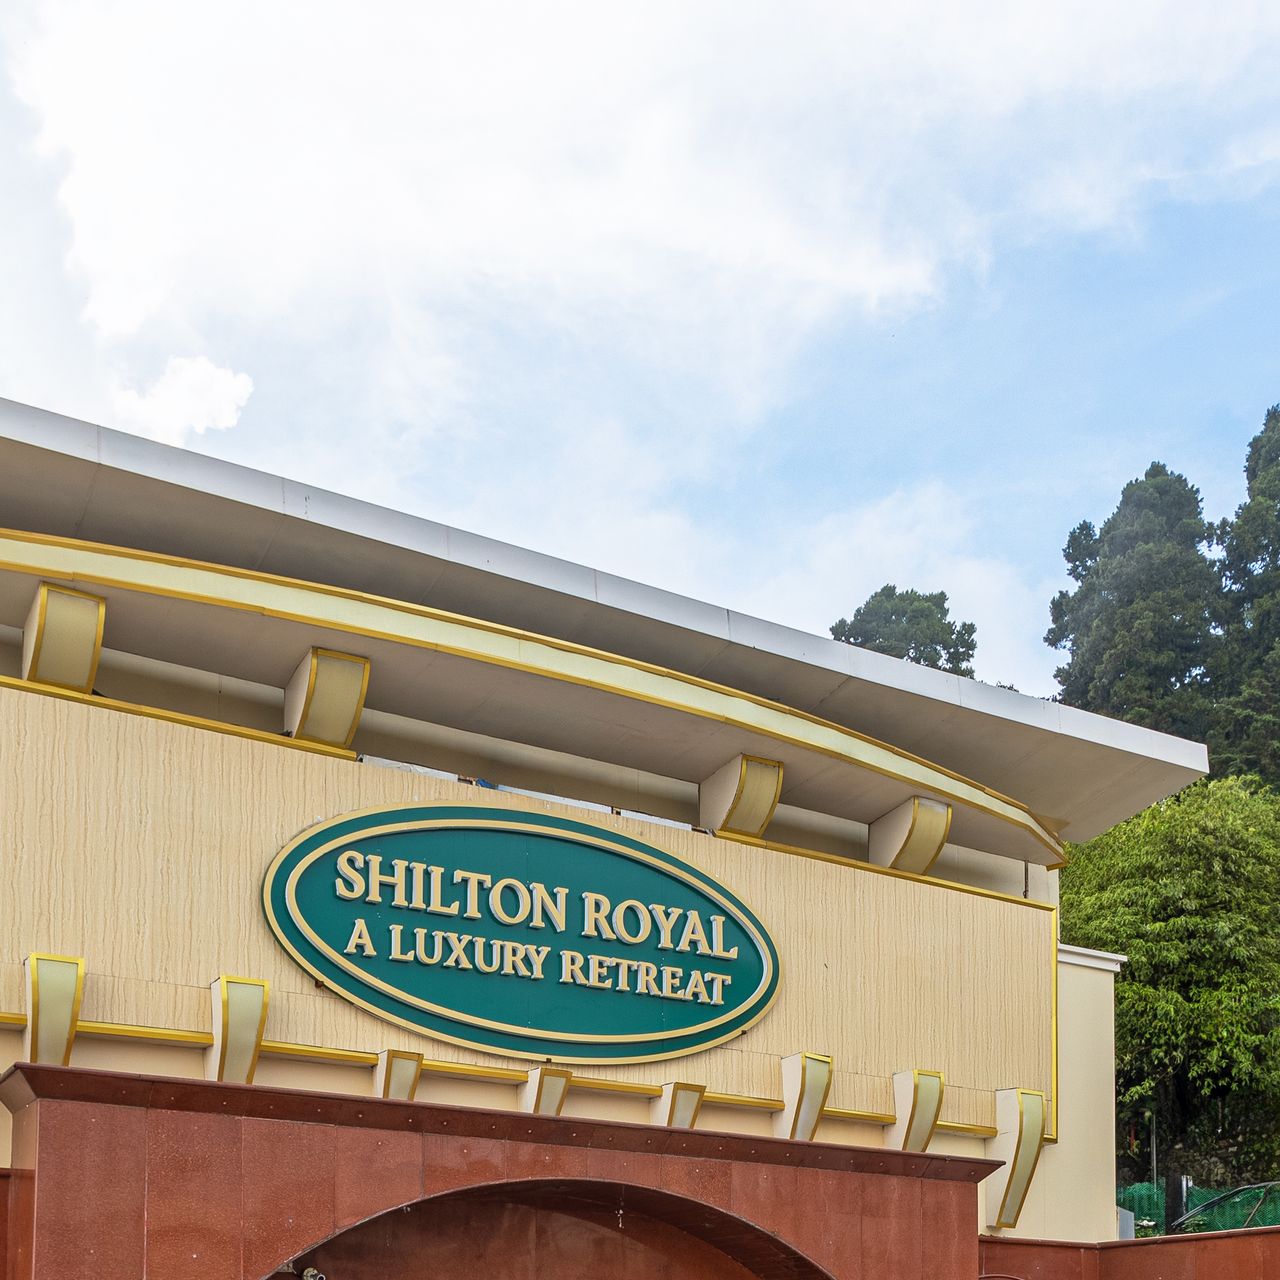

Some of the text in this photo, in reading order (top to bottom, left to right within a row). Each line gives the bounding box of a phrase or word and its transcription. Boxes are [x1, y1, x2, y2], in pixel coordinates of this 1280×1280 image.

[335, 849, 739, 960] SHILTON ROYAL
[344, 918, 732, 1006] A LUXURY RETREAT
